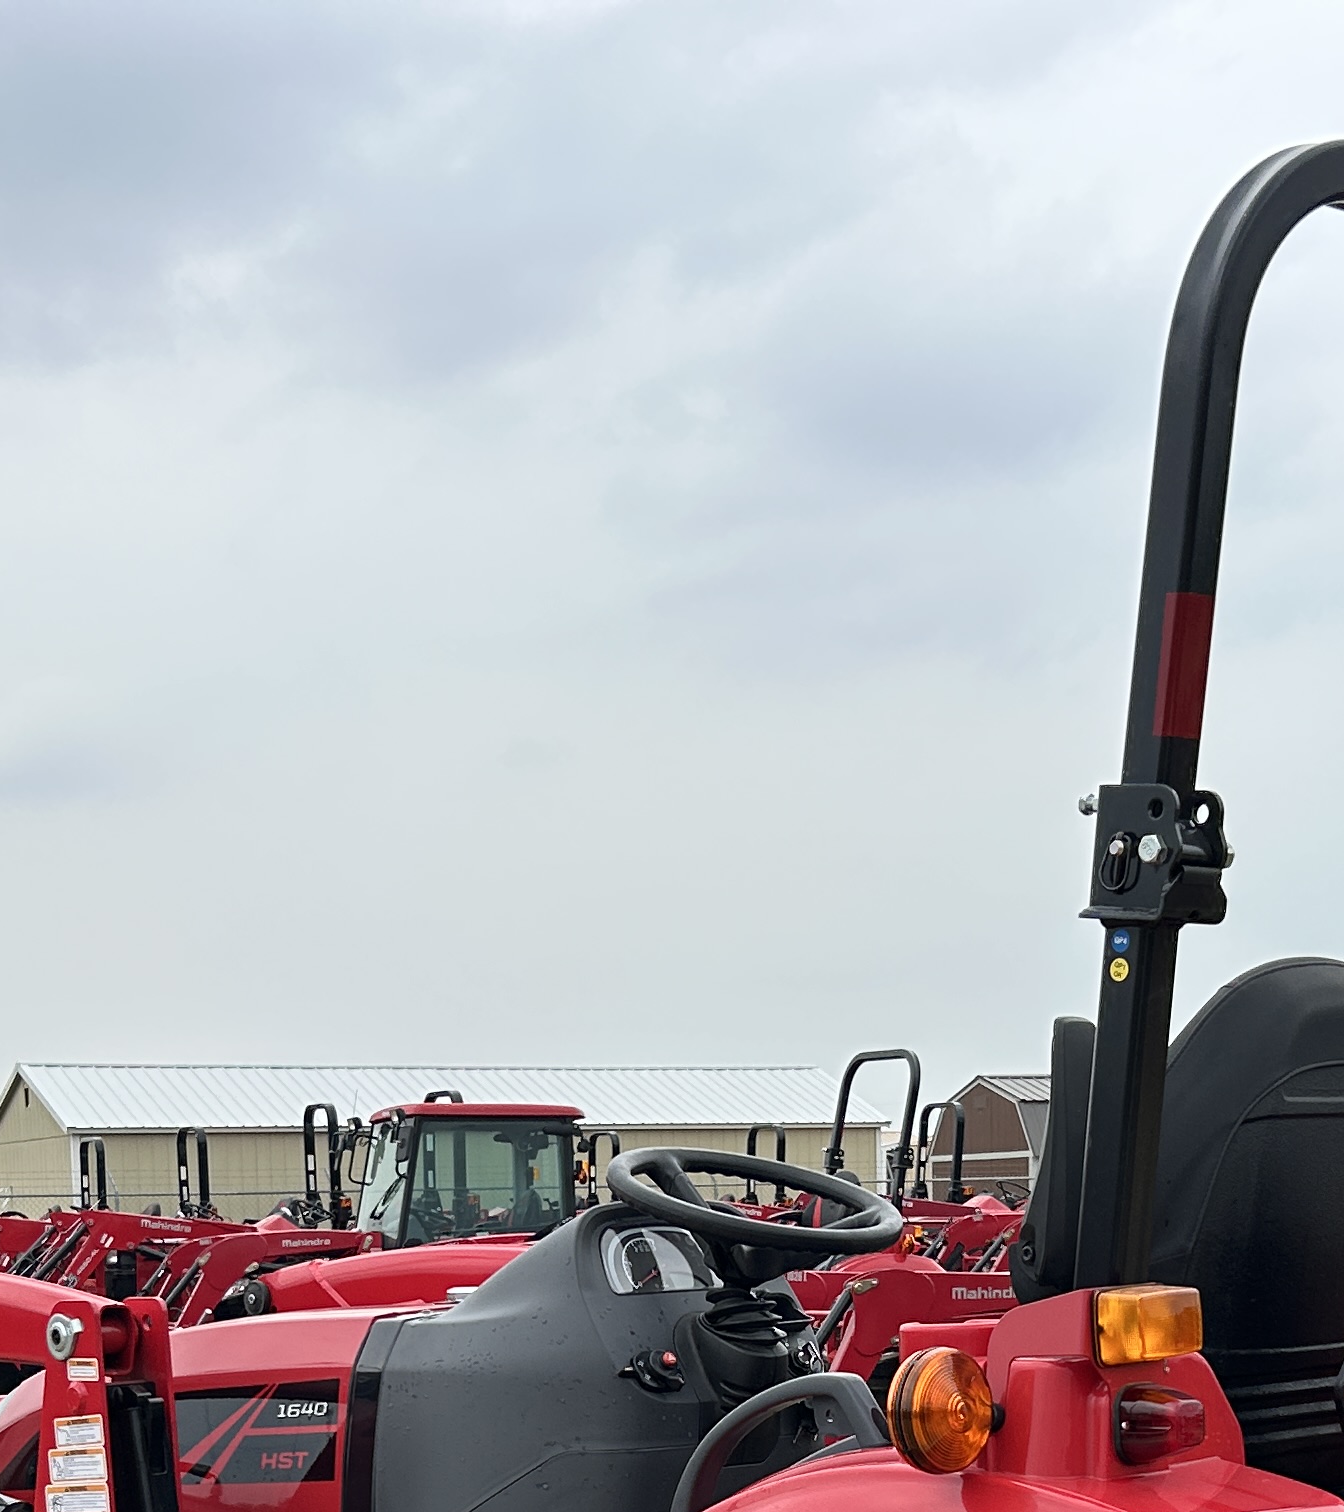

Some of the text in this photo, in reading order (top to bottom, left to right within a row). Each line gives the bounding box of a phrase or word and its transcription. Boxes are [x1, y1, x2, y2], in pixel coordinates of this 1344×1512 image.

[951, 1286, 1016, 1301] Mahind
[277, 1401, 328, 1418] 1640
[259, 1451, 310, 1470] HST
